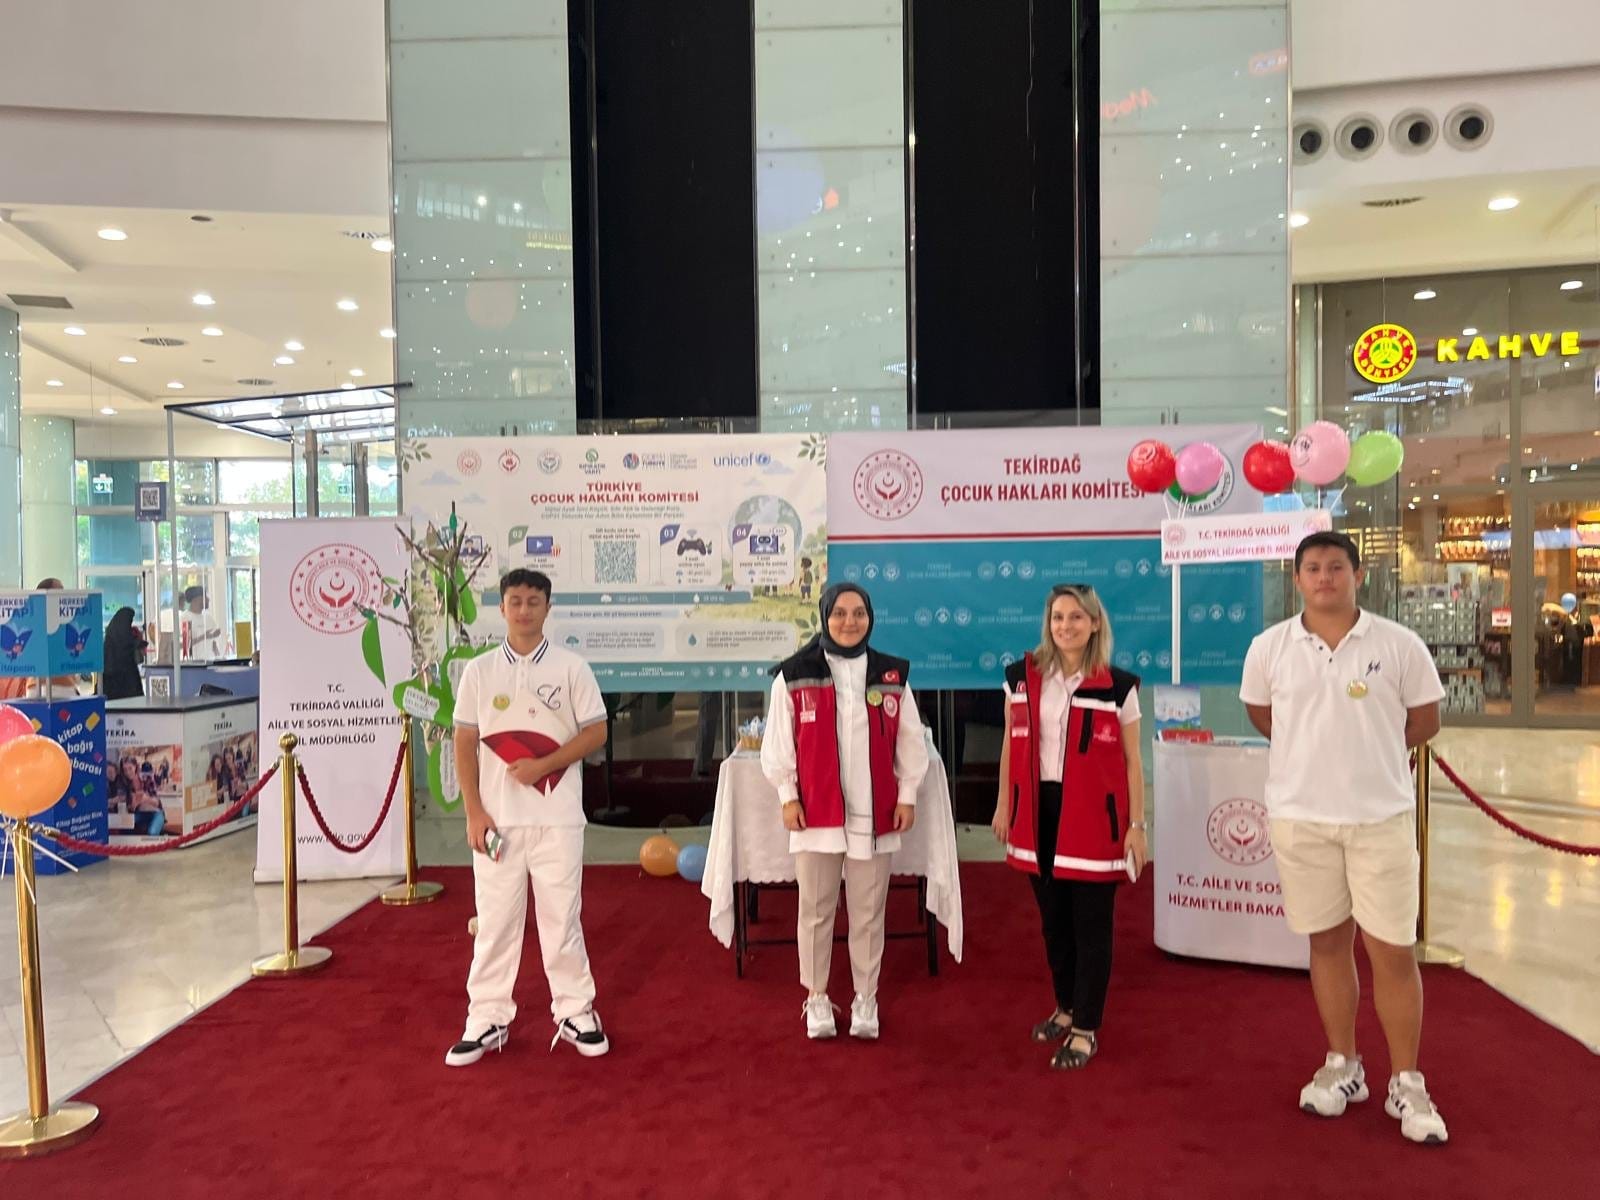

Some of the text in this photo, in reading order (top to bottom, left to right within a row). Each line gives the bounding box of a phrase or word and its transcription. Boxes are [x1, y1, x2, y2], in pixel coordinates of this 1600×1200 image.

[1437, 331, 1580, 361] KAHVE
[713, 452, 753, 467] unicef
[1004, 453, 1081, 476] TEKİRDAĞ
[586, 480, 642, 492] TÜRKİYE
[530, 491, 699, 506] ÇOCUK HAKLARI KOMİTESİ
[941, 484, 993, 507] ÇOCUK
[998, 482, 1067, 501] HAKLARI
[513, 530, 523, 539] 02
[664, 528, 674, 538] 03
[736, 528, 746, 537] 04
[1199, 525, 1290, 541] T.C. TEKİRDAĞ VALİLİĞİ
[1165, 551, 1180, 561] AİLE
[1181, 551, 1191, 560] VE
[1192, 549, 1221, 560] SOSYAL
[1222, 546, 1265, 557] HİZMETLER
[327, 684, 345, 693] T.C.
[289, 698, 384, 712] TEKİRDAĞ VALİLİĞİ
[268, 719, 289, 730] AİLE
[291, 720, 304, 729] VE
[307, 718, 345, 728] SOSYAL
[58, 723, 83, 745] kitap
[106, 728, 136, 737] TEKİRA
[298, 733, 376, 746] İL MÜDÜRLÜĞÜ
[67, 740, 94, 754] bağış
[71, 757, 102, 776] barası
[1176, 873, 1282, 896] T.C. AİLE VE SOS
[1168, 889, 1285, 917] HİZMETLER BAKA
